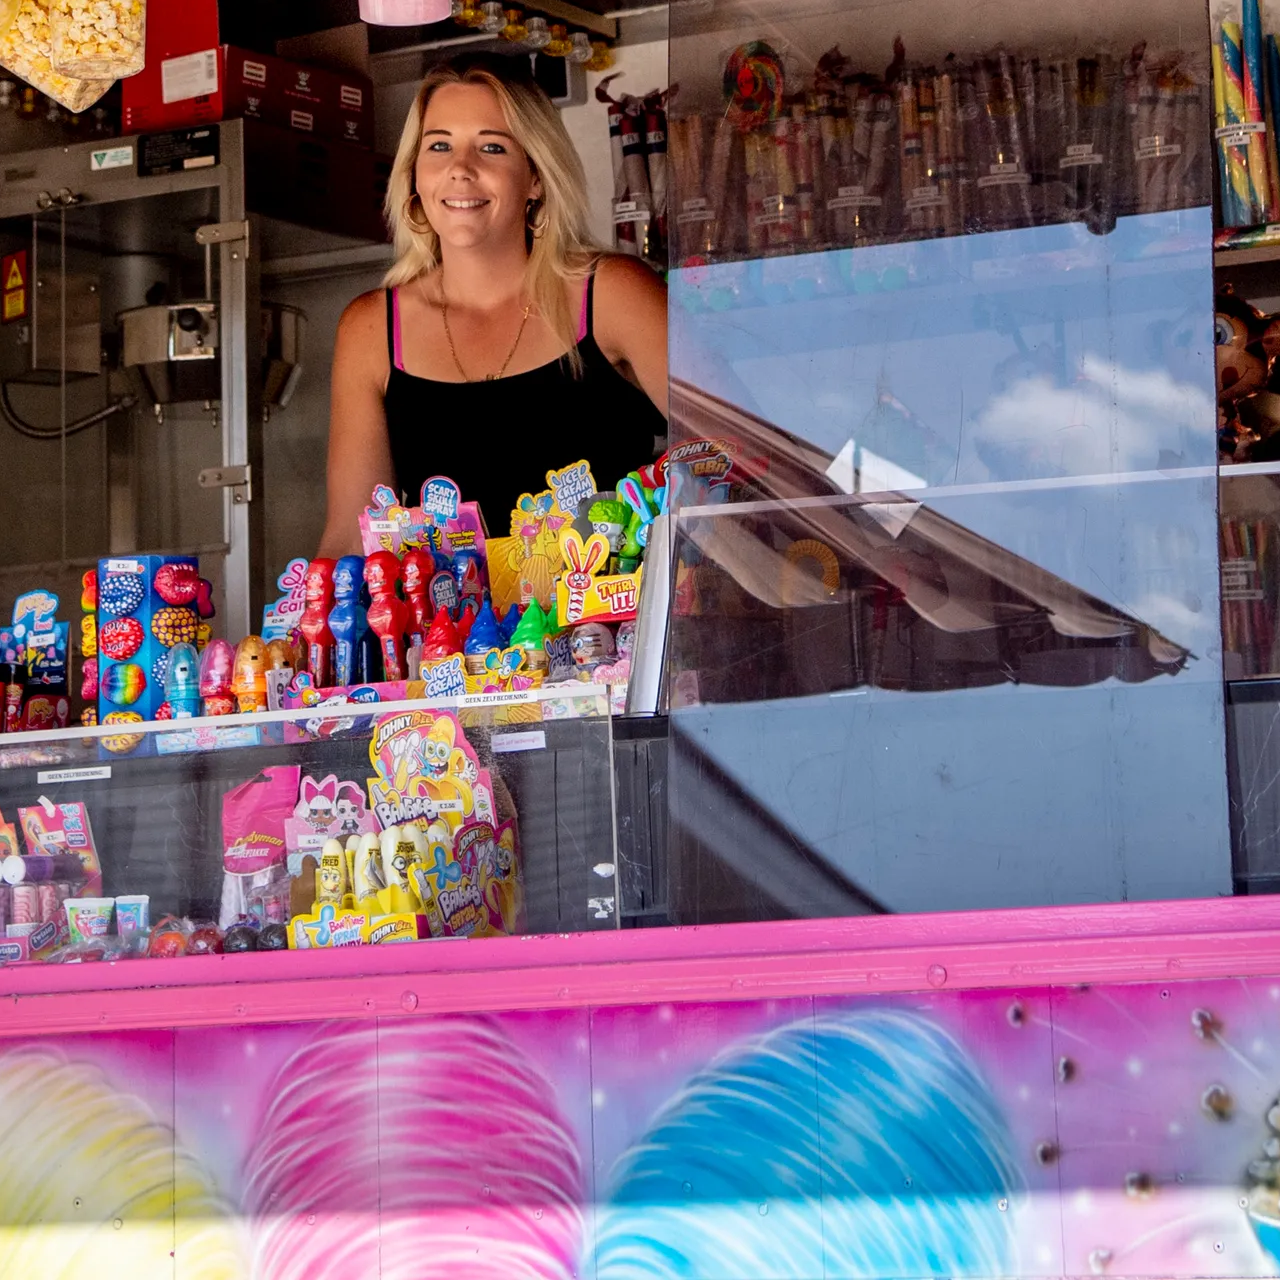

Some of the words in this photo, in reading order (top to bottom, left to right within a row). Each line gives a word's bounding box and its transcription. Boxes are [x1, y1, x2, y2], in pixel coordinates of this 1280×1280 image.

[560, 467, 580, 487] ICE
[427, 483, 457, 497] SCARY
[556, 477, 593, 500] CREAM
[427, 493, 455, 507] SKULL
[425, 503, 455, 518] SPRAY
[597, 580, 636, 600] TWiRL
[610, 590, 636, 611] IT!
[430, 661, 454, 680] ICE
[426, 673, 464, 696] CREAM
[465, 696, 481, 704] GEEN
[482, 693, 528, 703] ZELFBEDIENING
[376, 714, 412, 750] JOHNY
[322, 858, 339, 867] FRED
